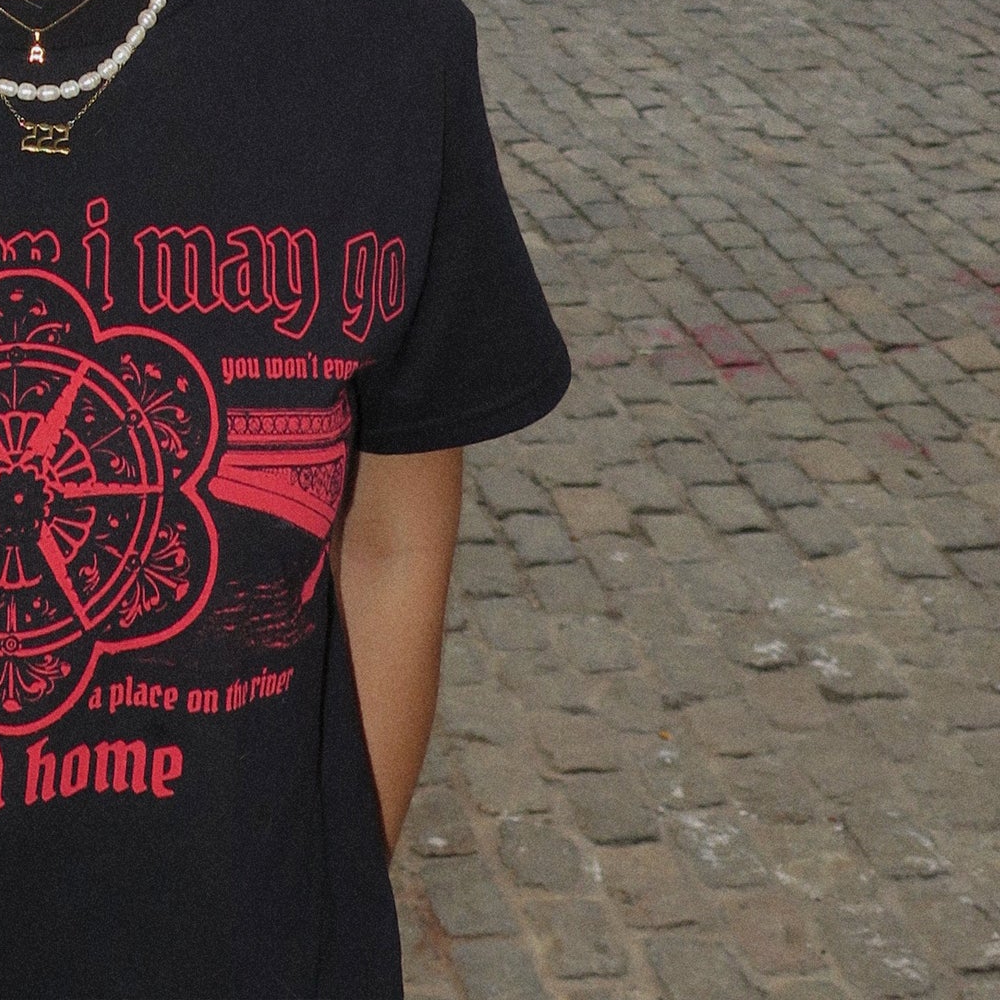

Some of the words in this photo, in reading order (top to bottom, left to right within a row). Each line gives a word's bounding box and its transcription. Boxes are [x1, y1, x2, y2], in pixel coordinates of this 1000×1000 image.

[21, 121, 70, 155] 222
[82, 197, 114, 312] i
[133, 225, 320, 340] may
[342, 231, 406, 344] go
[221, 356, 260, 385] you
[264, 351, 319, 380] won't
[88, 686, 102, 710] a
[109, 675, 179, 714] place
[187, 688, 219, 714] on
[249, 666, 294, 702] river
[25, 737, 184, 806] home
